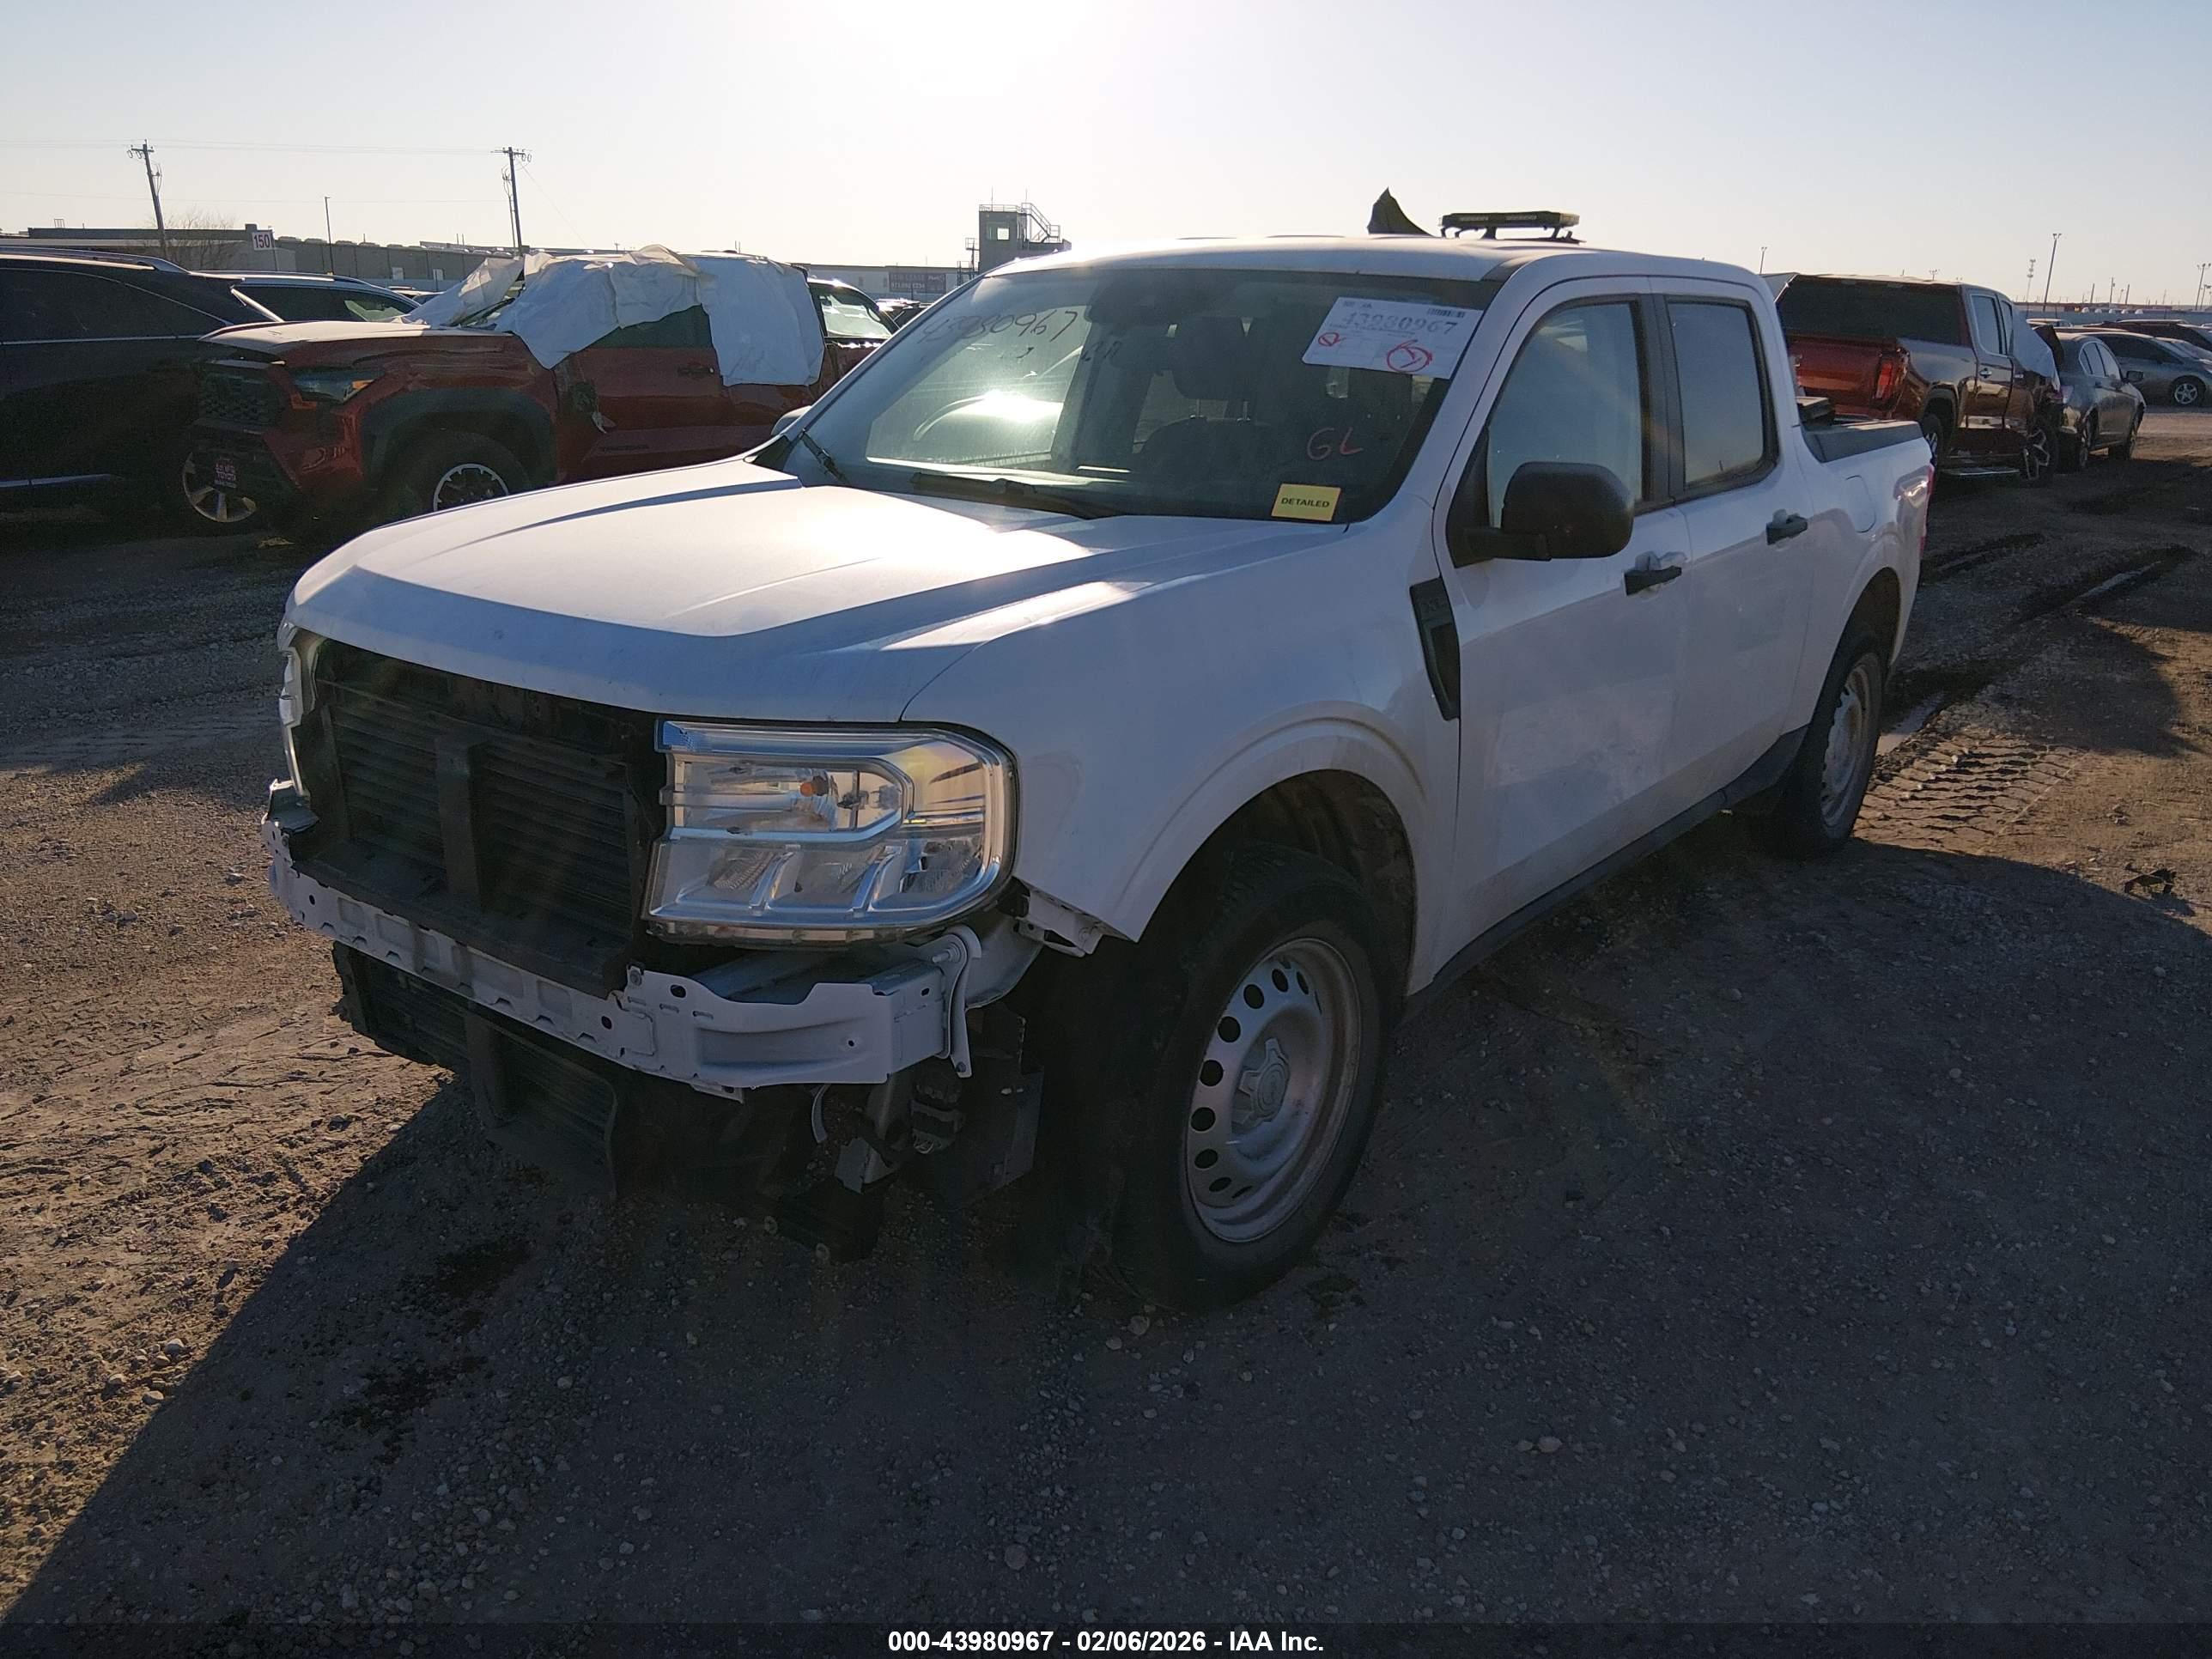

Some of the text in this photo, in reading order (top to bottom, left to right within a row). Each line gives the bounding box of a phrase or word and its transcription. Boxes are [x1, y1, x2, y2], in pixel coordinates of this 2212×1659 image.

[253, 234, 270, 248] 150
[1306, 427, 1364, 461] GL
[1280, 496, 1331, 508] DETAILED
